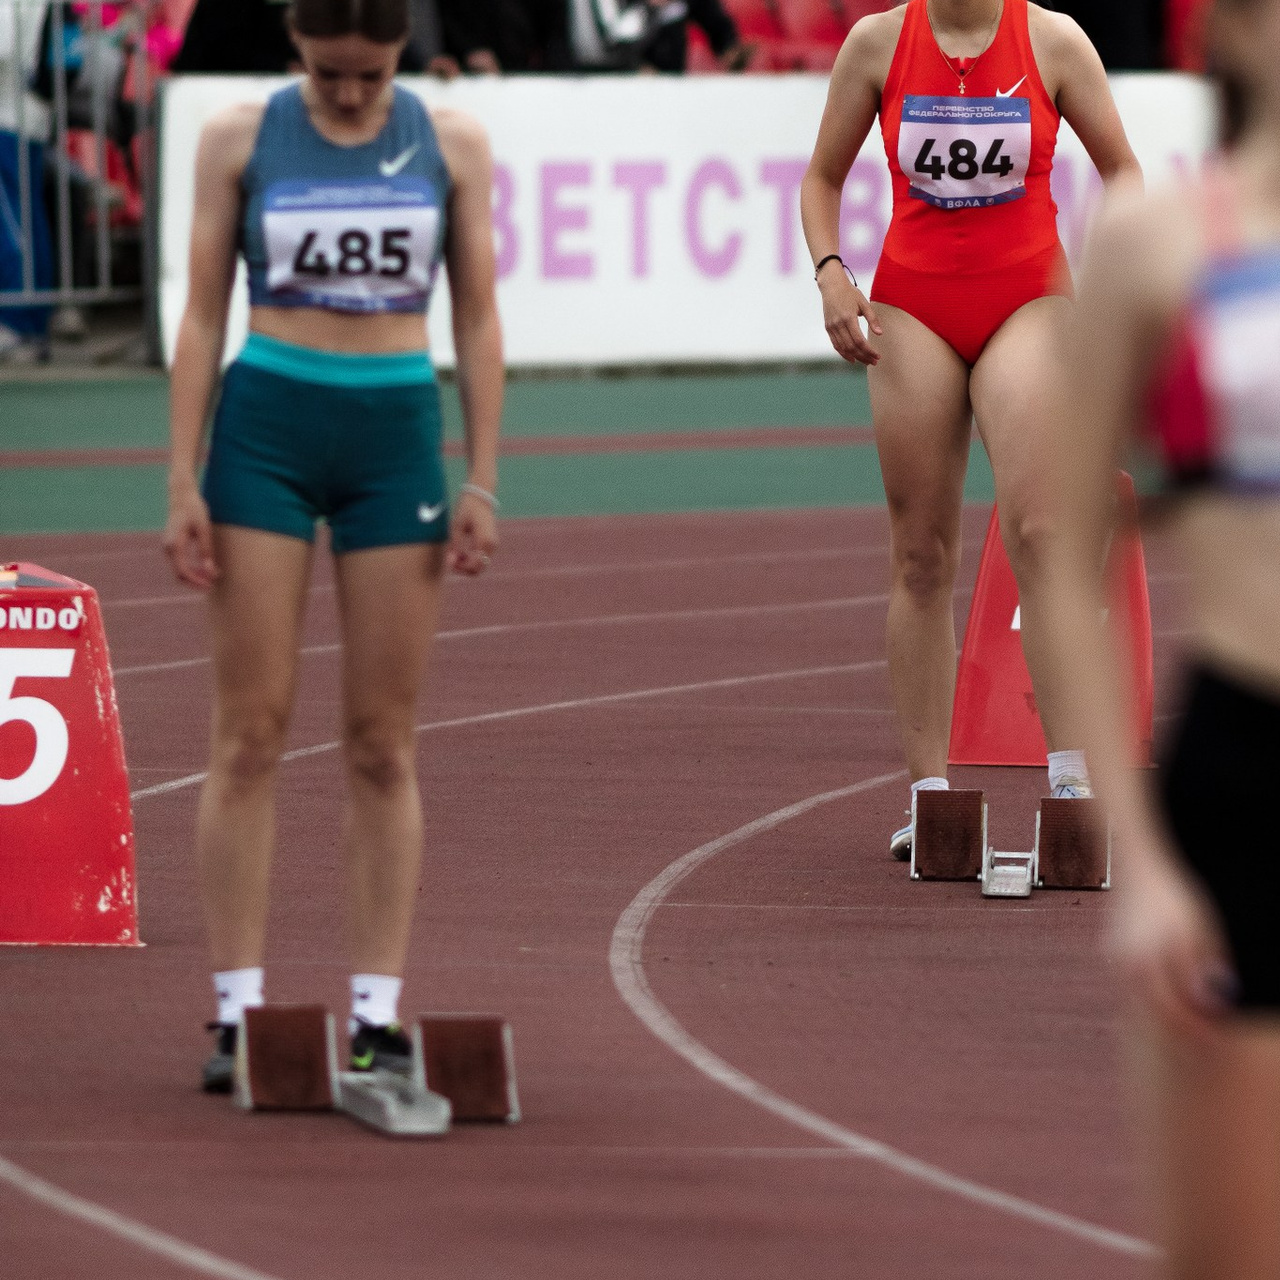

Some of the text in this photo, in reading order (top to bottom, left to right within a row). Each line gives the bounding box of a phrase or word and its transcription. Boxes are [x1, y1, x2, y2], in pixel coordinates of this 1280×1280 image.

[908, 109, 983, 118] ФЕДЕРАЛЬНОГО
[914, 138, 1014, 180] 484
[946, 199, 981, 209] ВФЛА
[293, 228, 412, 278] 485
[0, 607, 80, 630] NDO
[0, 648, 77, 806] 5
